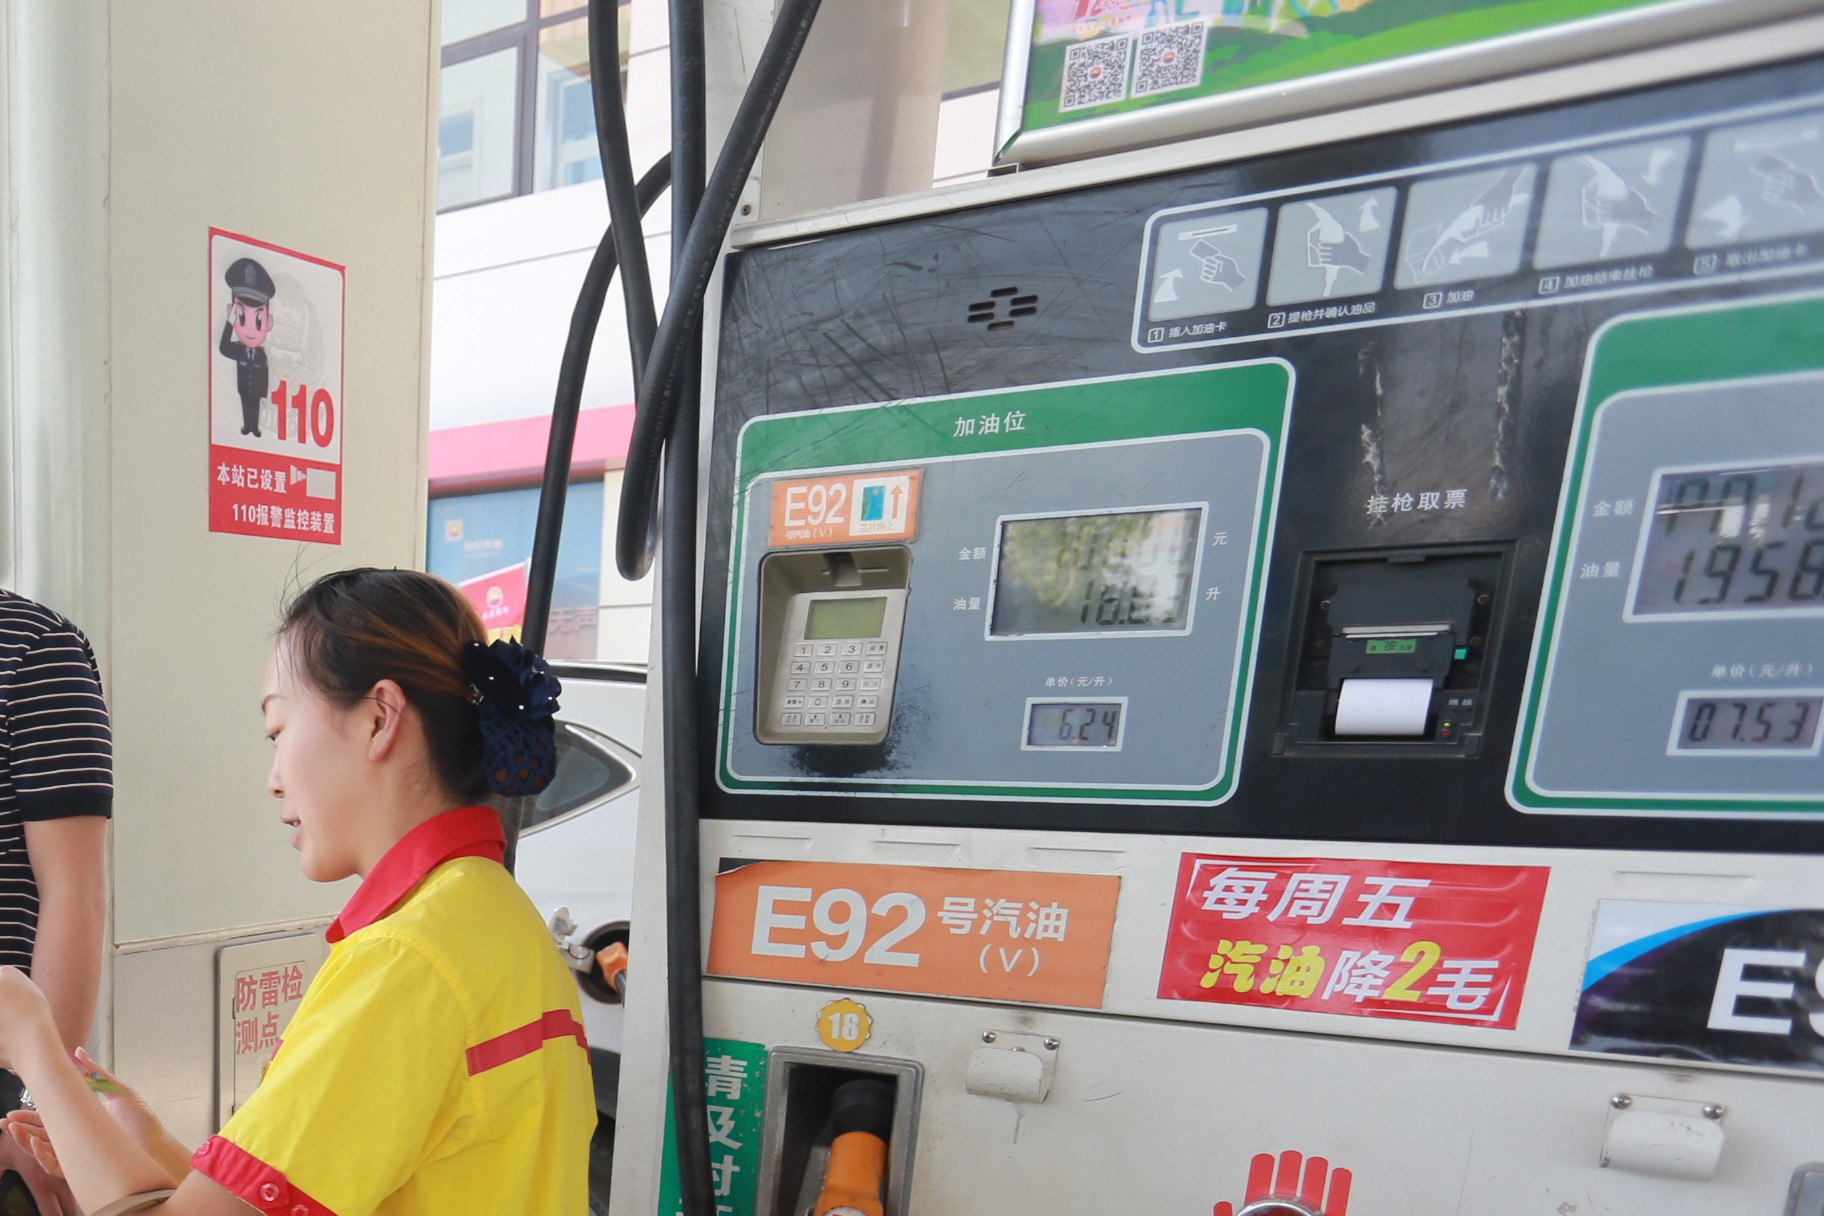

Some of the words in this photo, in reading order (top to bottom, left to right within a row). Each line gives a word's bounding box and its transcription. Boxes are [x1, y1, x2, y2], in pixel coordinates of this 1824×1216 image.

[1446, 290, 1474, 304] 加油
[1288, 302, 1376, 323] 提枪并确认油品
[1168, 321, 1226, 338] 插入加油卡
[271, 380, 334, 448] 110
[953, 410, 1027, 438] 加油位
[217, 462, 287, 494] 本站已设置
[784, 483, 847, 526] E92
[1366, 487, 1469, 516] 挂枪取票
[1592, 499, 1635, 517] 金额
[232, 503, 335, 535] 110报警监控装置
[958, 547, 987, 560] 金额
[1211, 532, 1228, 546] 元
[1580, 561, 1621, 579] 油量
[953, 597, 982, 611] 油量
[1205, 587, 1221, 601] 升
[1200, 868, 1432, 930] 每周五
[751, 885, 927, 968] E92
[937, 896, 1070, 942] 号汽油
[235, 965, 304, 1013] 防雷检
[1199, 940, 1499, 1011] 汽油降2毛
[1706, 947, 1824, 1040] E
[236, 1011, 280, 1056] 测点
[828, 1012, 860, 1041] 18
